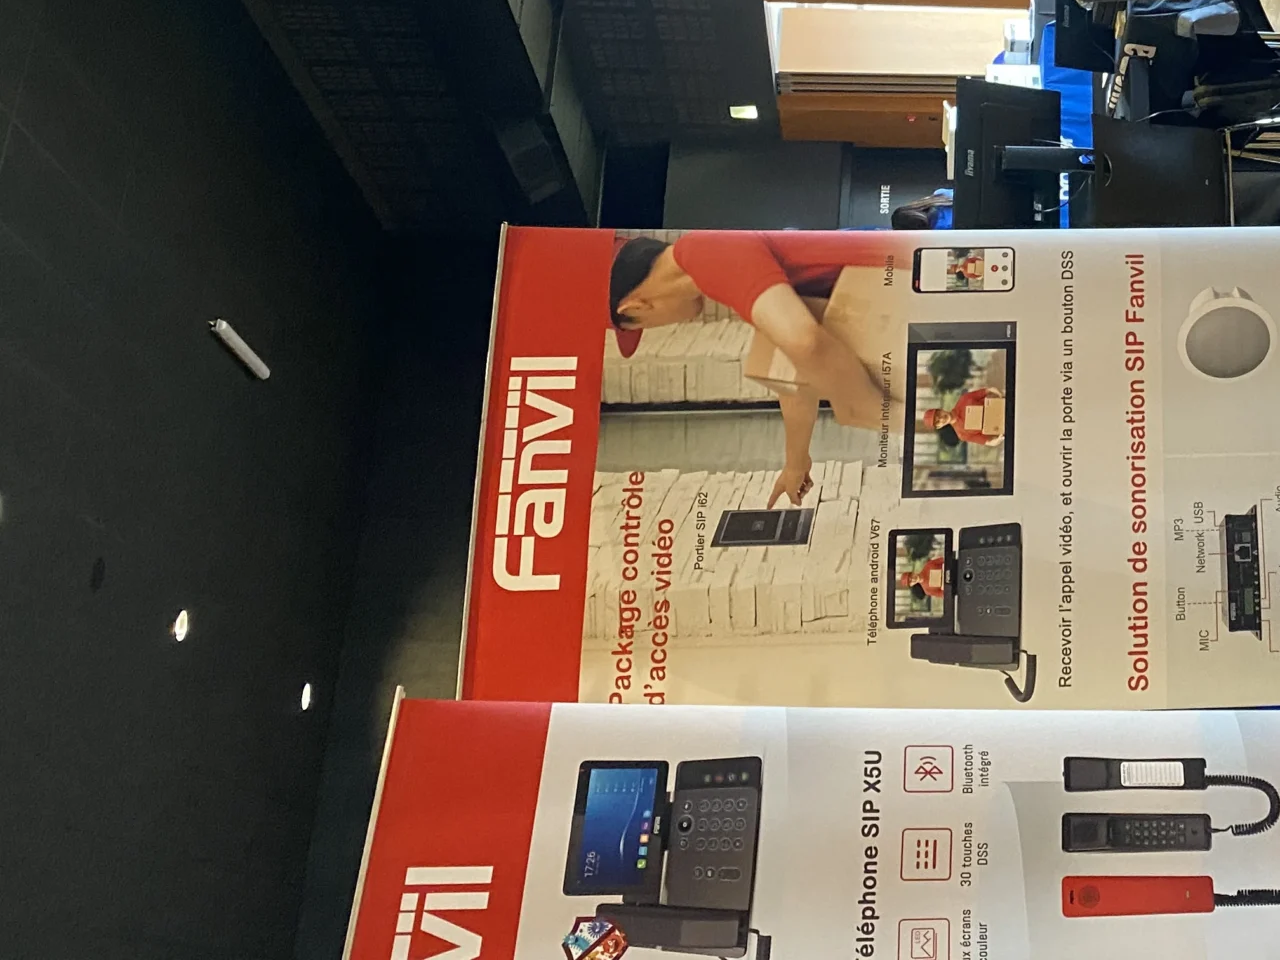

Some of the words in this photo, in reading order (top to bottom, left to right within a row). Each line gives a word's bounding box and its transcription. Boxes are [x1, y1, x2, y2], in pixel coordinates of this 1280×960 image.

[879, 184, 891, 214] SORTIE
[884, 254, 895, 287] Mobile
[1061, 250, 1074, 280] DSS
[1125, 253, 1145, 323] Fanvil
[1061, 285, 1074, 334] bouton
[881, 351, 893, 375] i57A
[1063, 339, 1073, 356] un
[1125, 331, 1145, 372] SIP
[1059, 361, 1073, 382] via
[879, 377, 891, 421] intérieur
[1060, 387, 1075, 423] porte
[877, 423, 890, 468] Moniteur
[1059, 428, 1073, 441] la
[492, 356, 578, 591] Fanvil
[1059, 445, 1073, 487] ouvrir
[1125, 379, 1147, 534] sonorisation
[697, 491, 708, 508] i62
[1060, 492, 1072, 506] et
[1194, 501, 1204, 524] USB
[619, 471, 645, 581] contrôle
[695, 511, 706, 530] SIP
[870, 518, 881, 539] V67
[1058, 511, 1074, 556] vidéo,
[1174, 518, 1184, 541] MP3
[651, 518, 674, 591] vidéo
[693, 534, 705, 570] Portier
[868, 543, 880, 584] android
[1127, 541, 1147, 573] de
[1195, 531, 1206, 573] Network
[867, 587, 880, 646] Téléphone
[1176, 587, 1186, 621] Button
[609, 589, 641, 704] Package
[1058, 617, 1072, 687] Recevoir
[1127, 581, 1149, 692] Solution
[1199, 629, 1210, 651] MIC
[863, 750, 882, 793] X5U
[962, 744, 974, 794] Bluetooth
[979, 751, 991, 787] intégré
[861, 800, 881, 838] SIP
[961, 822, 973, 868] touches
[978, 842, 989, 865] DSS
[961, 872, 972, 887] 30
[855, 846, 880, 960] éléphone
[960, 909, 971, 947] écrans
